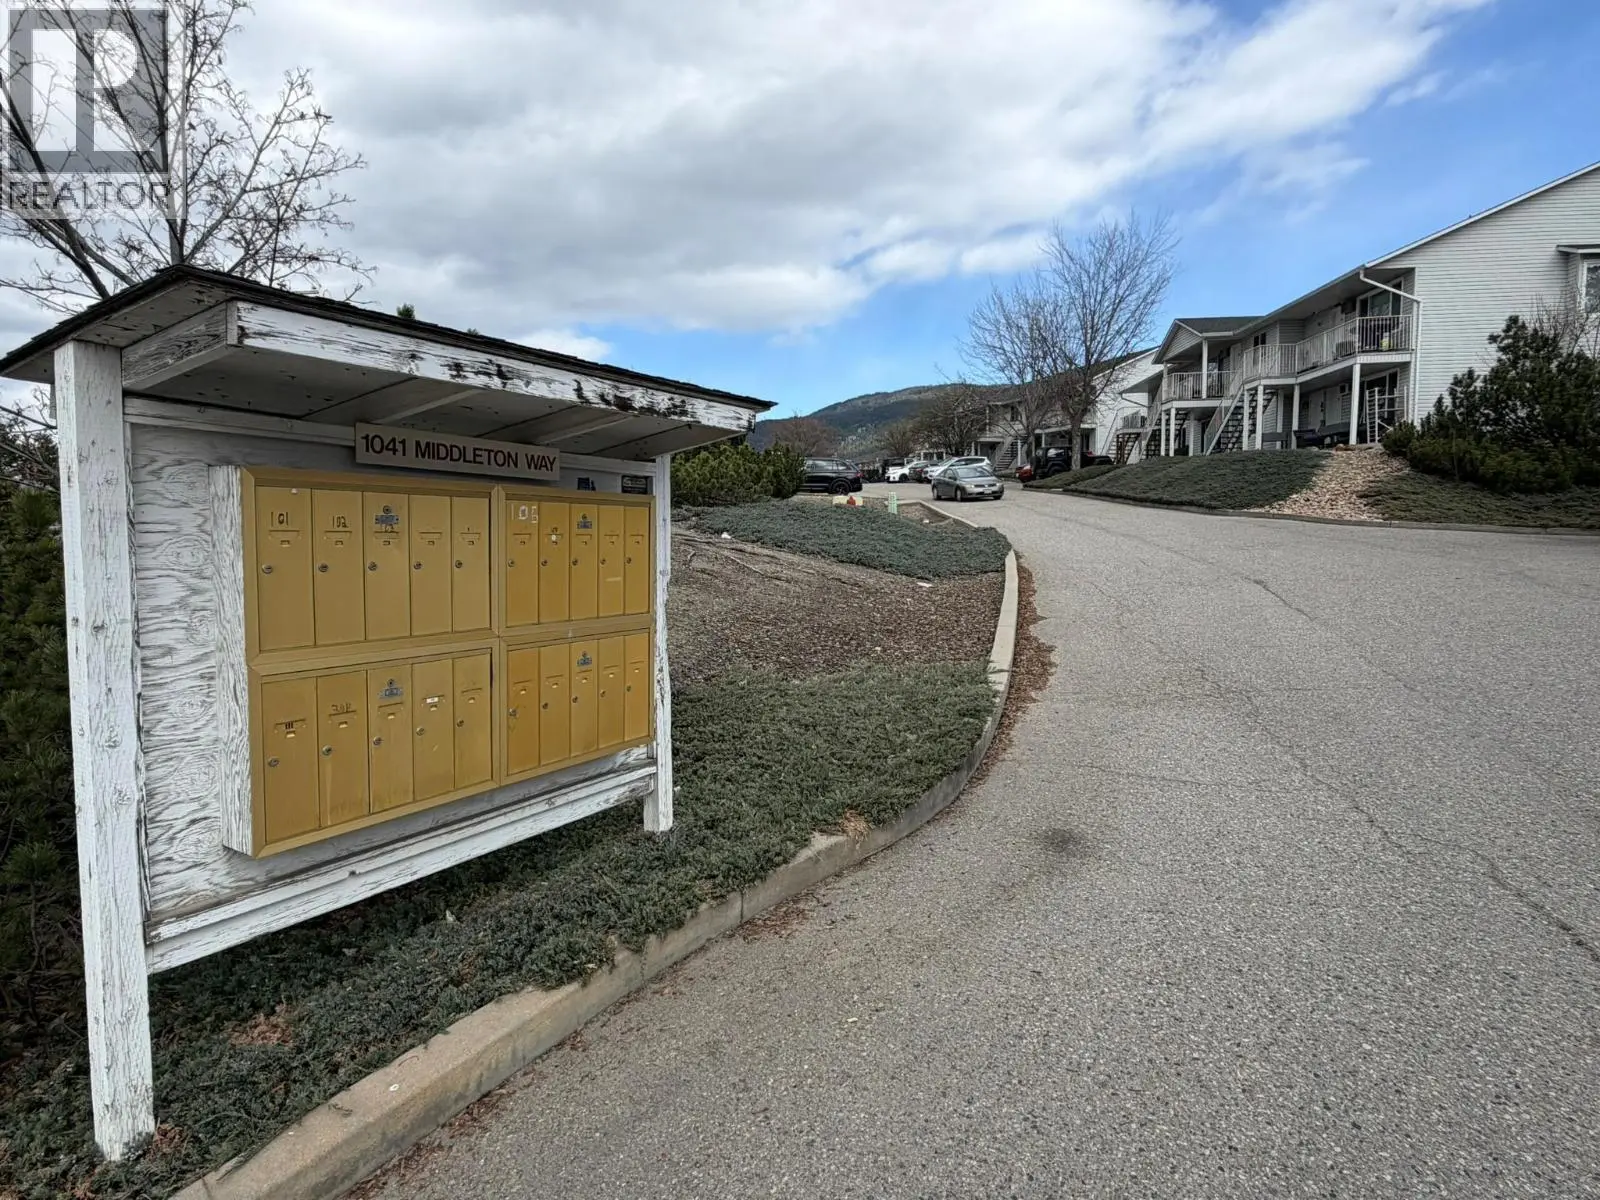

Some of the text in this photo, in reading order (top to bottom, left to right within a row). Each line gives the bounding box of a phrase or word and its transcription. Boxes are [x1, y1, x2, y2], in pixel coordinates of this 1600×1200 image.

[361, 433, 557, 472] 1041 MIDDLETON WAY
